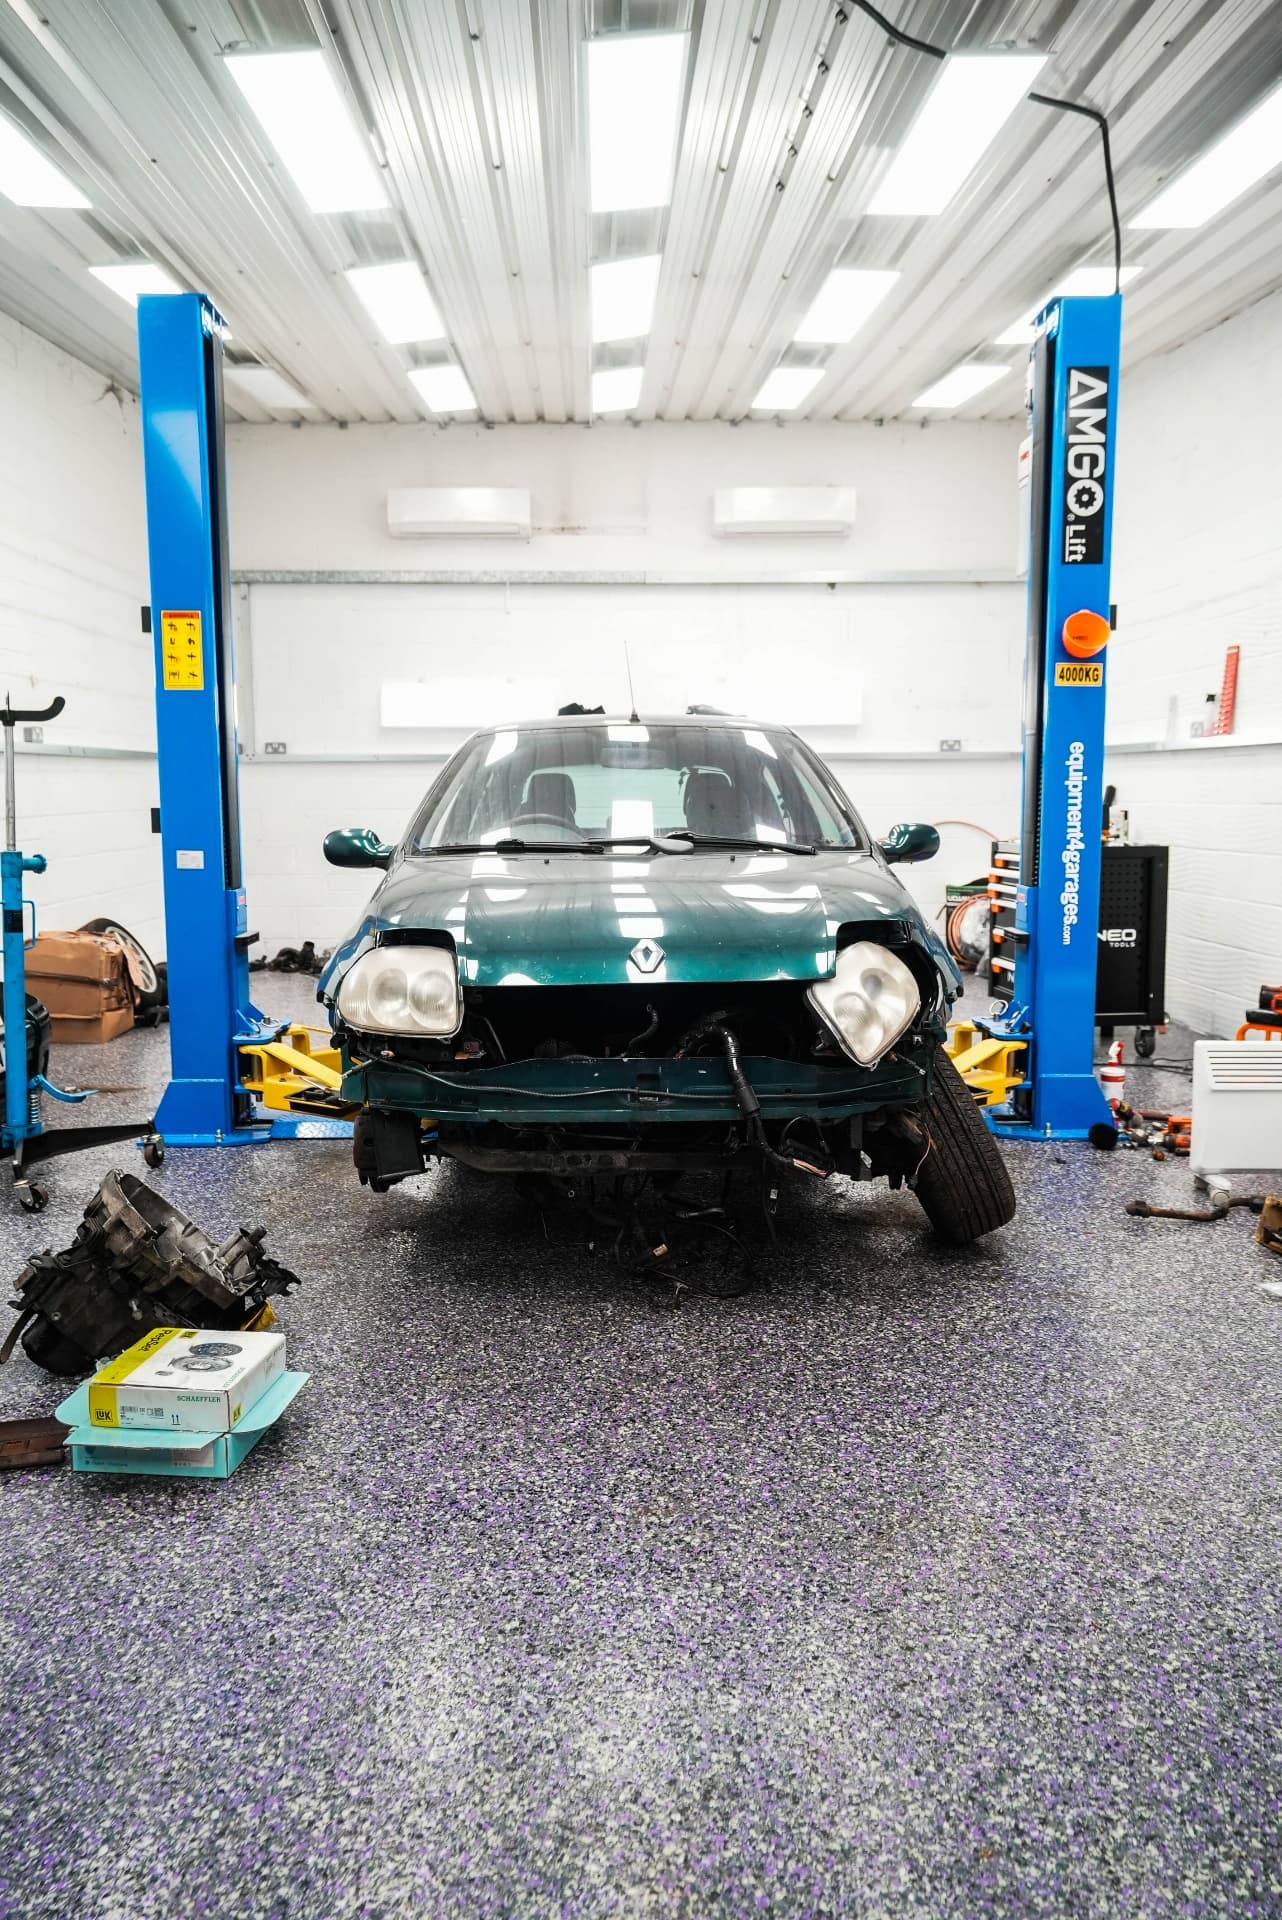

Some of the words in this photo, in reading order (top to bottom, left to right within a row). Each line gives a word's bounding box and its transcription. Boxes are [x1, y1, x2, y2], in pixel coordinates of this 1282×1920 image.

[1065, 524, 1086, 563] Lift
[1059, 667, 1099, 682] 4000KG
[1060, 741, 1088, 945] equipment4garages.com
[1096, 929, 1137, 942] NEO
[177, 1395, 221, 1403] SCHAEFFLER
